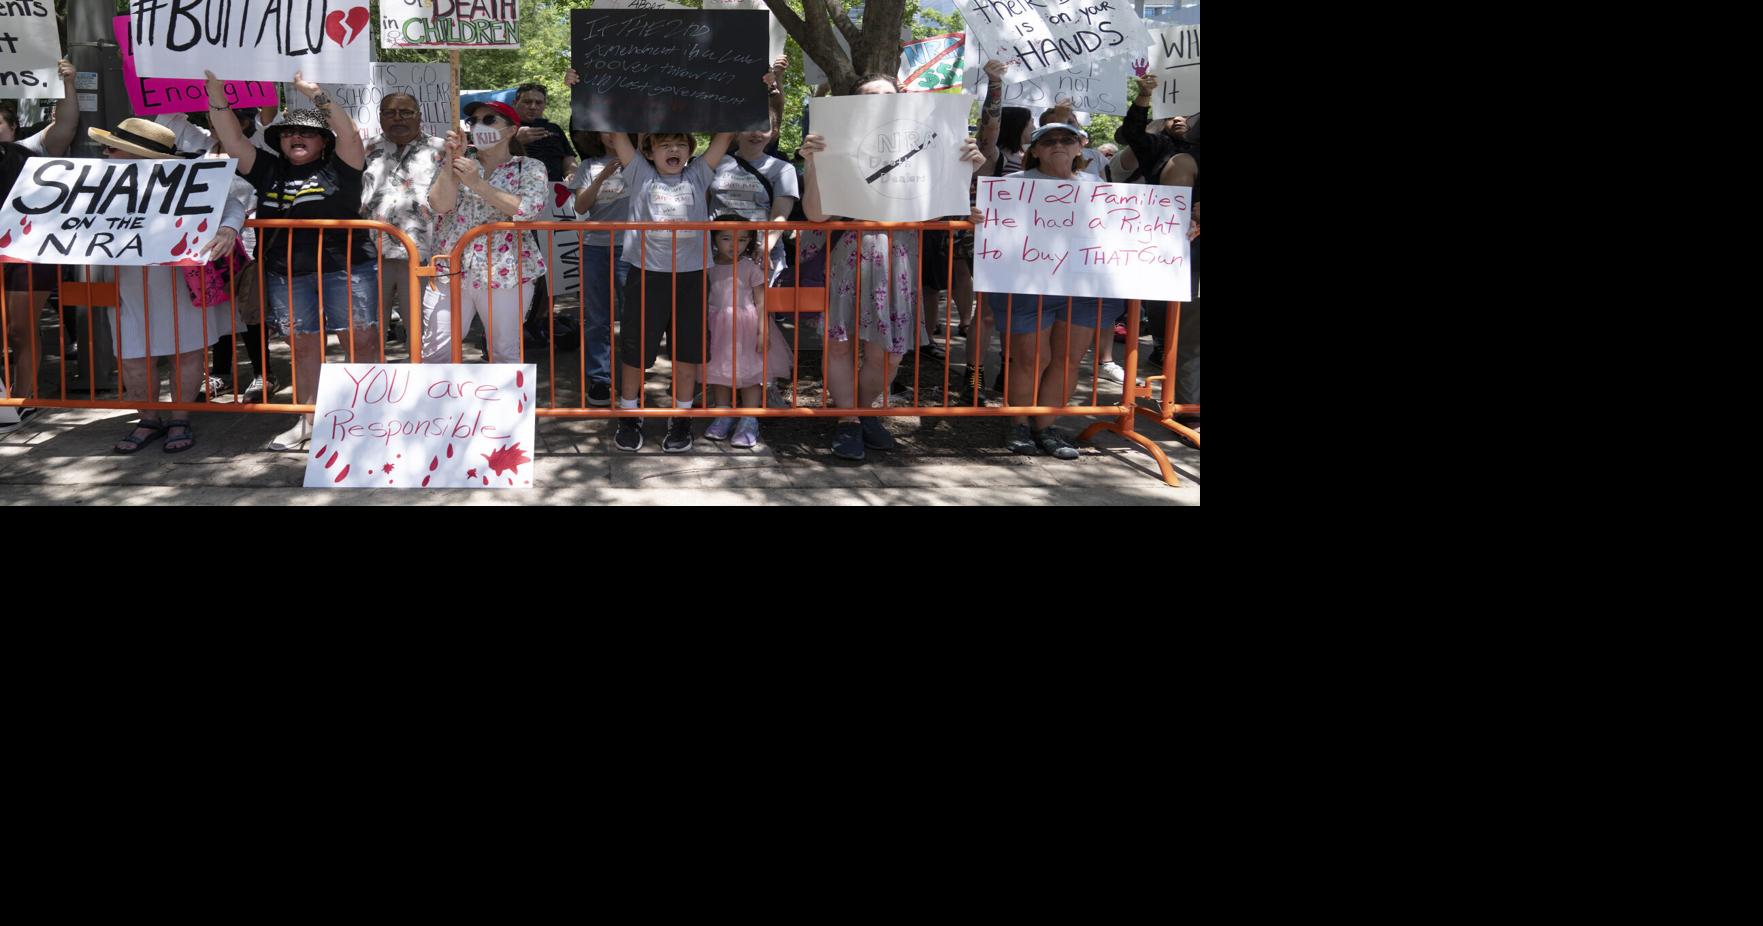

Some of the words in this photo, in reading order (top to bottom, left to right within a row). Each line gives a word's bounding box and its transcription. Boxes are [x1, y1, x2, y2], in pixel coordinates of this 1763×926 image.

[382, 16, 399, 30] in
[402, 16, 520, 45] CHILDREN
[1049, 12, 1071, 25] on
[1013, 21, 1124, 71] HANDS
[411, 65, 437, 85] GO
[476, 132, 500, 145] KILL
[877, 130, 937, 153] NRA
[12, 160, 228, 217] SHAME
[982, 180, 1036, 204] Tell
[1045, 183, 1081, 204] 21
[1091, 184, 1187, 211] Families
[61, 216, 97, 230] ON
[106, 217, 147, 230] THE
[984, 207, 1018, 229] He
[1034, 209, 1075, 229] had
[1089, 217, 1106, 230] a
[1107, 207, 1181, 244] Right
[37, 232, 144, 258] NRA
[977, 238, 1002, 260] to
[1022, 235, 1070, 275] buy
[1079, 246, 1138, 266] THAT
[343, 366, 410, 408] YOU
[427, 379, 502, 400] are
[324, 408, 512, 446] Responsible
